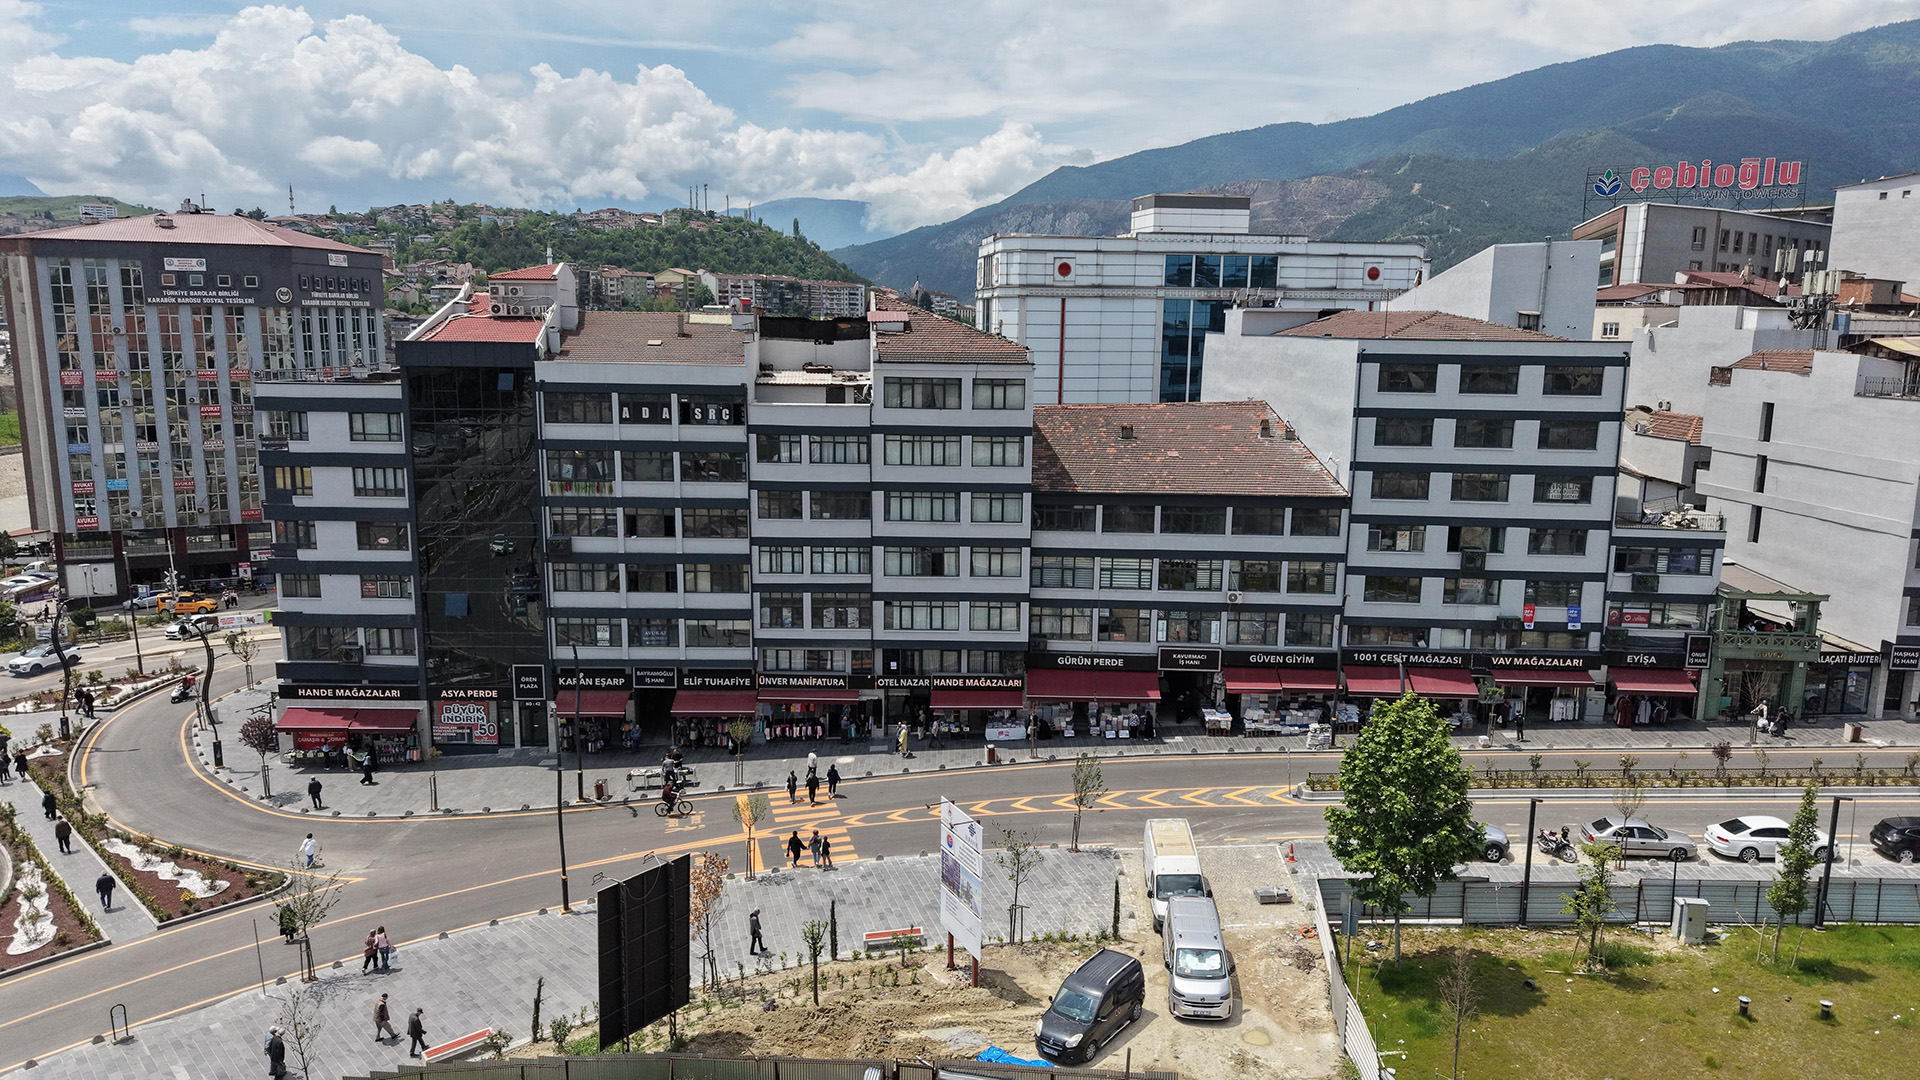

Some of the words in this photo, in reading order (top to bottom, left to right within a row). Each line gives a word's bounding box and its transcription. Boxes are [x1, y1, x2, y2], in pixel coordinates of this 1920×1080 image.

[1630, 157, 1802, 193] çebioğlu
[1692, 188, 1730, 200] TWIN
[1735, 188, 1799, 200] TOWERS
[1057, 655, 1090, 665] GÜRÜN
[1093, 657, 1124, 666] PERDE
[1250, 653, 1283, 664] GÜVEN
[1285, 654, 1314, 664] GİYİM
[1354, 653, 1377, 661] 1001
[1380, 653, 1408, 664] ÇEŞİT
[1409, 654, 1462, 664] MAĞAZASI
[1492, 657, 1512, 665] VAV
[1514, 656, 1583, 667] MAĞAZALARI
[1627, 654, 1656, 665] EYİŞA
[1848, 654, 1882, 663] BİJUTERİ
[595, 678, 625, 687] EŞARP
[683, 676, 702, 686] ELİF
[705, 676, 751, 686] TUHAFİYE
[759, 675, 787, 686] ÜNVER
[789, 675, 845, 686] MANİFATURA
[878, 678, 899, 686] OTEL
[900, 678, 930, 686] NAZAR
[933, 678, 964, 686] HANDE
[966, 677, 1022, 687] MAĞAZALARI
[298, 688, 333, 697] HANDE
[335, 687, 400, 697] MAĞAZALARI
[444, 704, 484, 715] BÜYÜK
